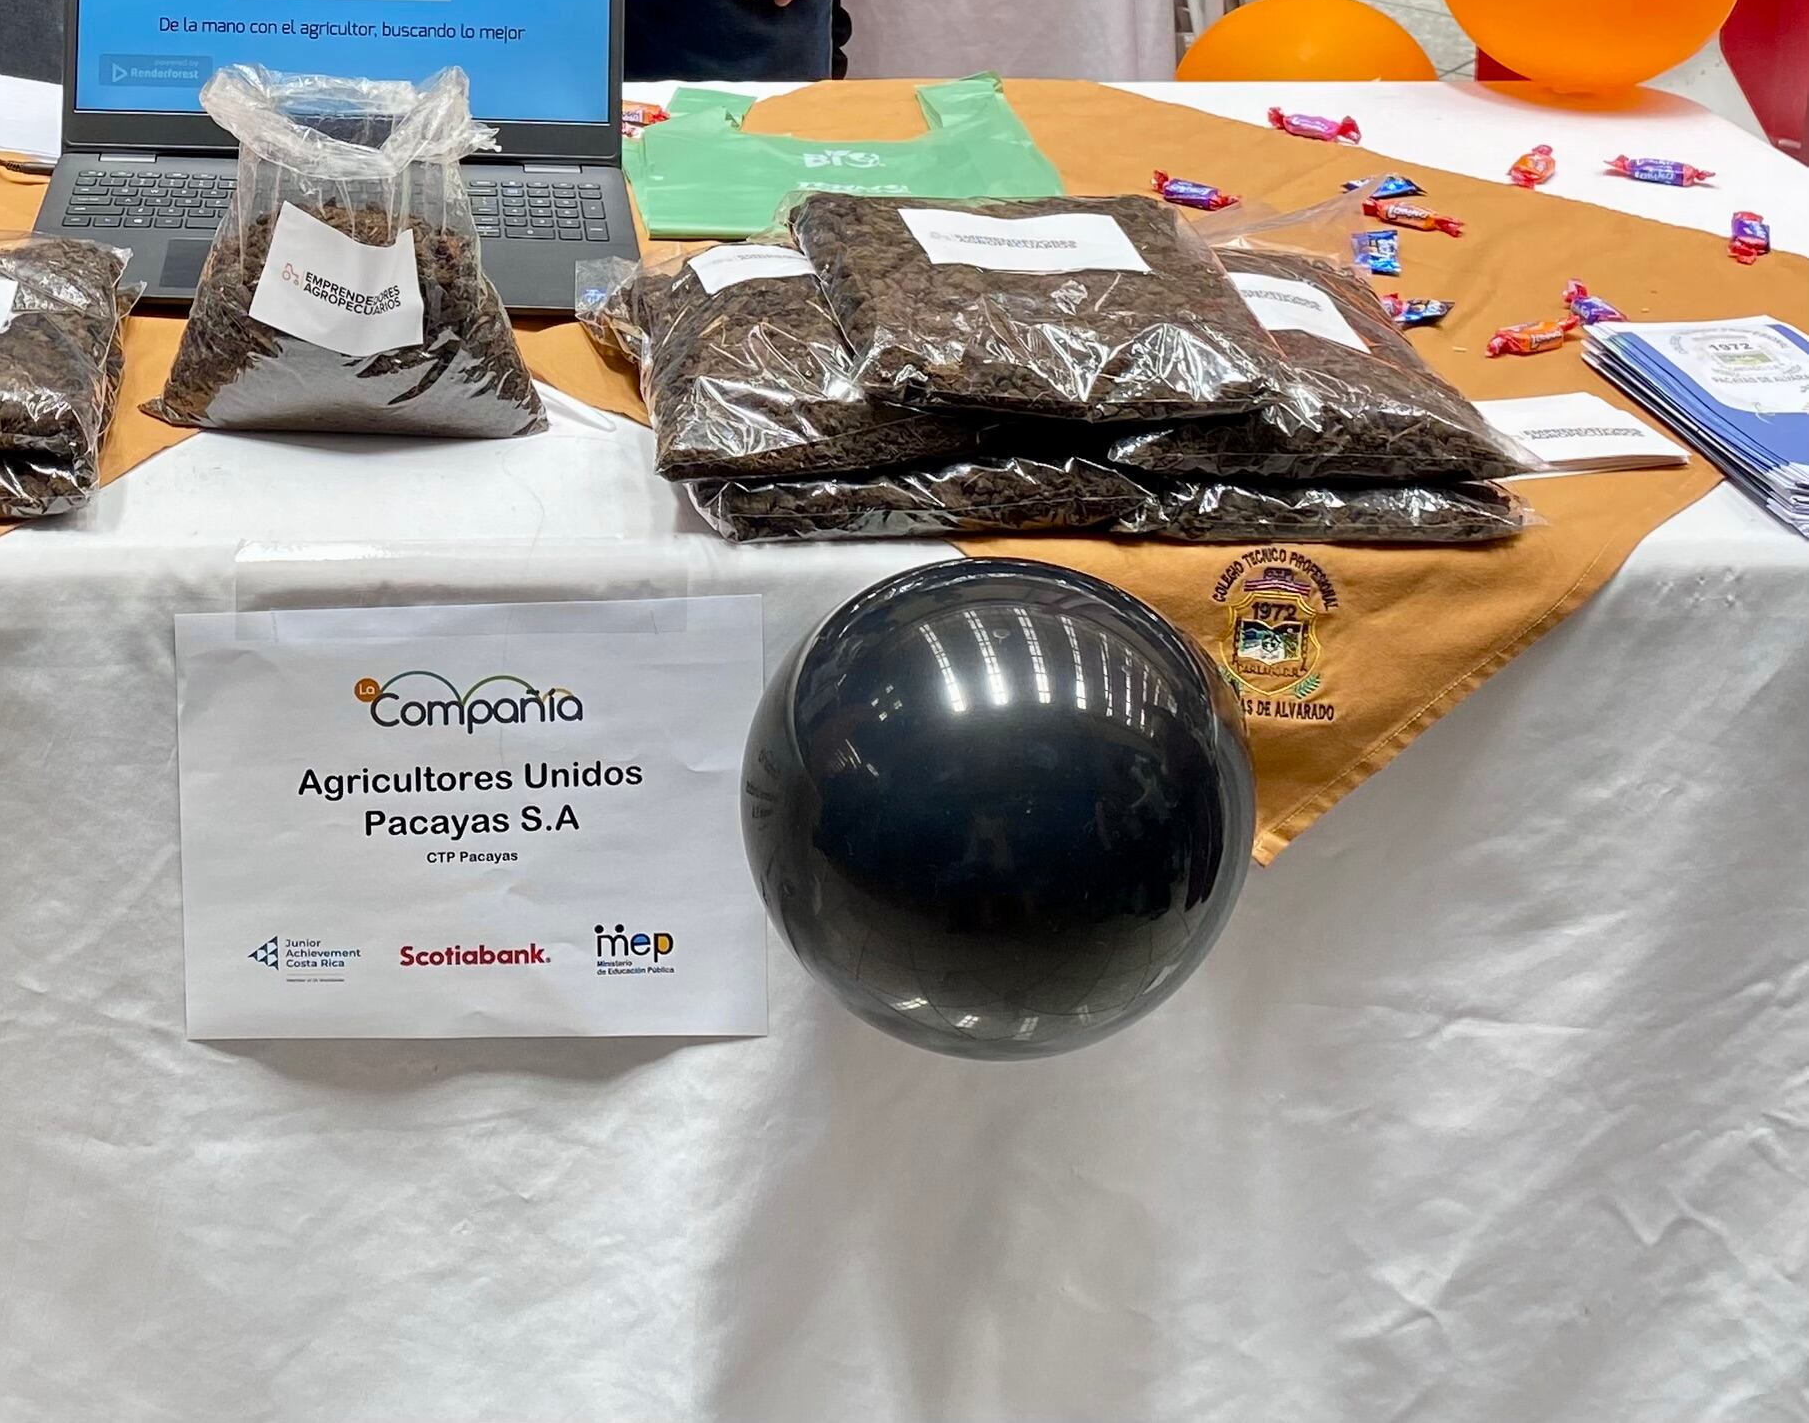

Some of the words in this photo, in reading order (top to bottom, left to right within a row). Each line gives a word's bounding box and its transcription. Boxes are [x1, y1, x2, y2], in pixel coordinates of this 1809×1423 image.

[159, 17, 178, 32] De
[183, 18, 198, 32] la
[201, 20, 246, 34] mano
[250, 21, 277, 35] con
[282, 20, 296, 35] el
[300, 21, 378, 39] agricultor,
[382, 24, 456, 39] buscando
[461, 24, 475, 39] lo
[479, 25, 525, 44] mejor
[130, 68, 199, 79] Renderforest
[305, 271, 401, 306] EMPRENDEDORES
[303, 283, 401, 316] AGROPECUARIOS
[1708, 342, 1754, 352] 1972
[1212, 560, 1244, 603] COLEGIO
[1242, 547, 1287, 567] TECNICO
[1251, 601, 1297, 622] 1972
[359, 683, 375, 695] La
[370, 688, 584, 735] Compañía
[1256, 701, 1272, 717] DE
[1274, 701, 1335, 721] ALVARADO
[298, 766, 513, 802] Agricultores
[524, 760, 643, 789] Unidos
[365, 810, 510, 841] Pacayas
[520, 804, 580, 833] S.A
[426, 851, 456, 864] CTP
[459, 850, 519, 864] Pacayas
[285, 939, 321, 948] Junior
[285, 949, 362, 958] Achievement
[594, 924, 674, 963] mep
[286, 959, 318, 968] Costa
[320, 959, 345, 968] Rica
[596, 968, 607, 976] de
[607, 967, 646, 976] Educación
[647, 966, 675, 974] Pública
